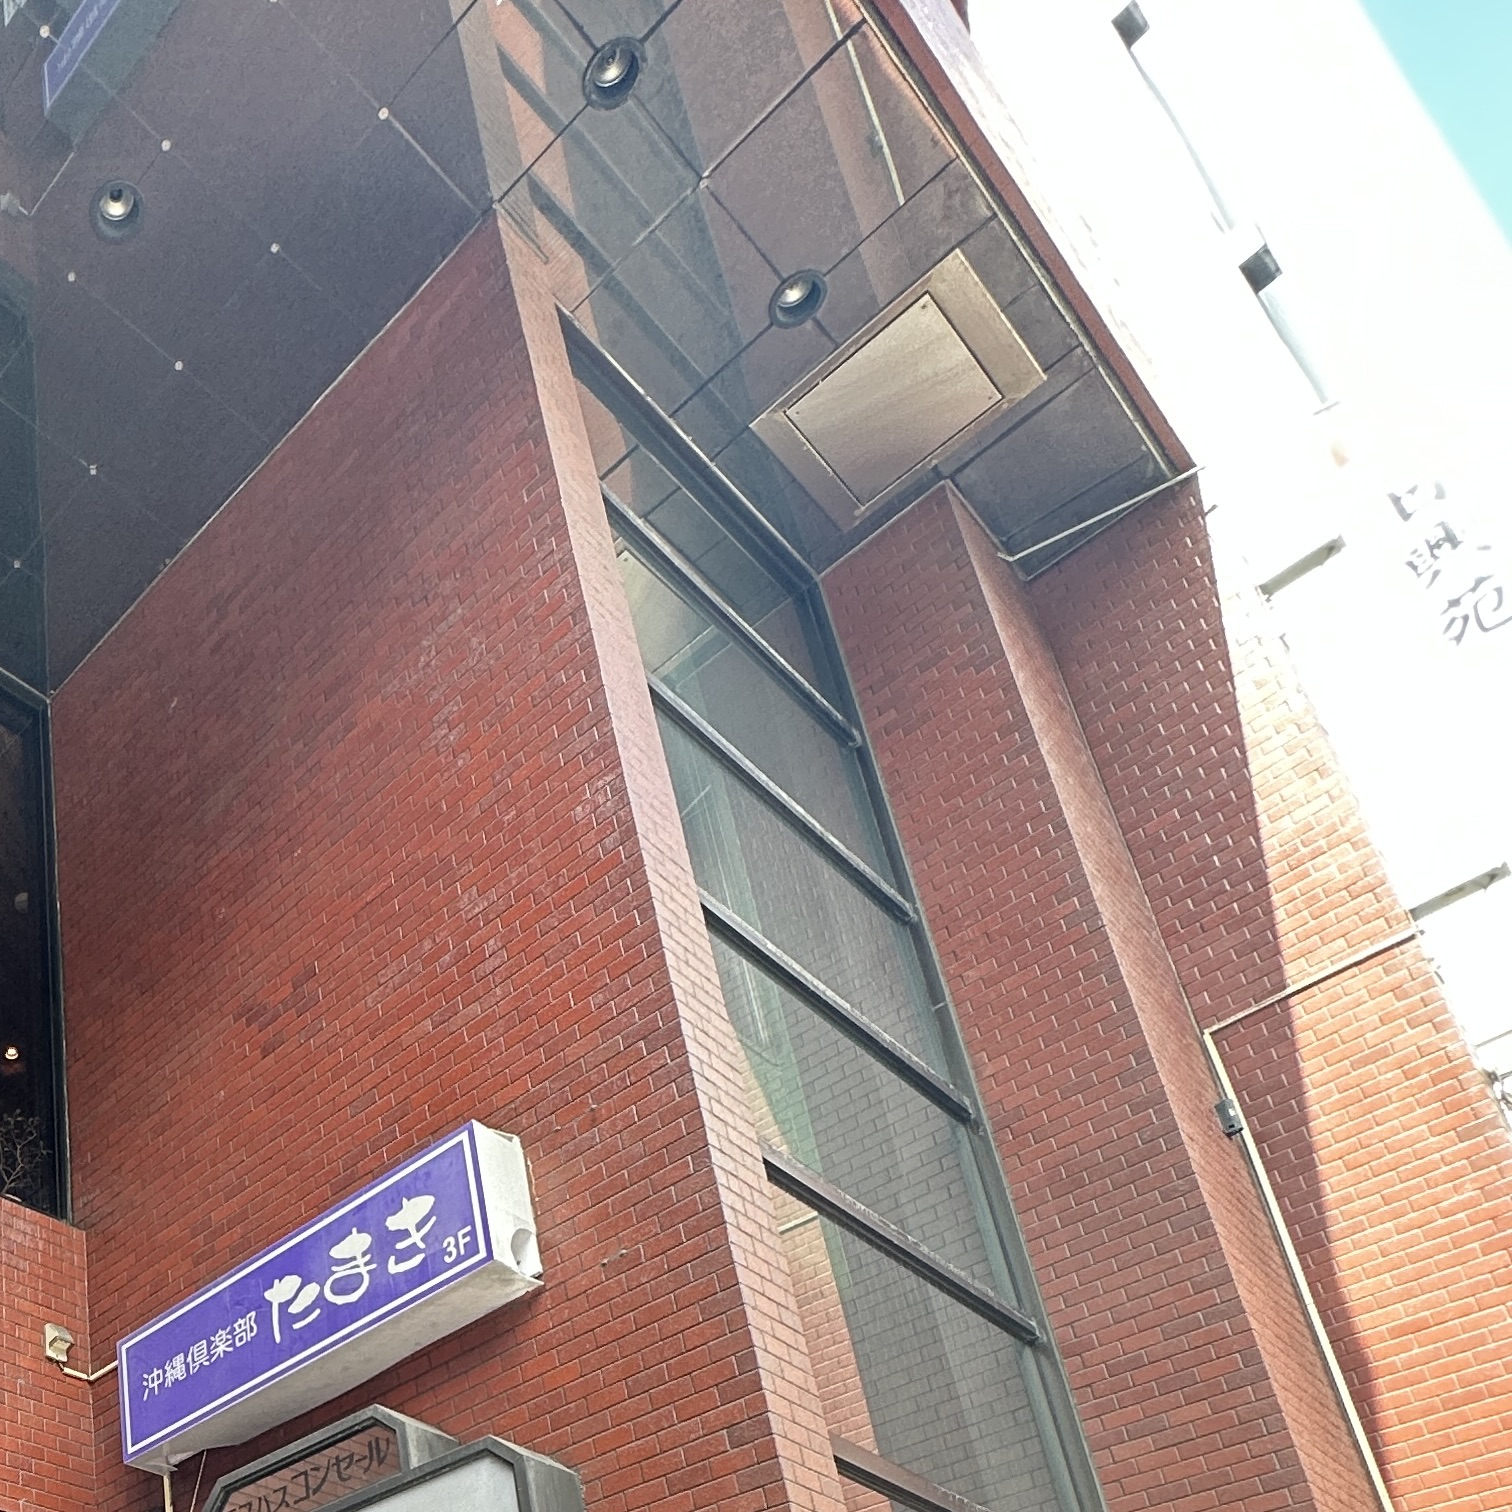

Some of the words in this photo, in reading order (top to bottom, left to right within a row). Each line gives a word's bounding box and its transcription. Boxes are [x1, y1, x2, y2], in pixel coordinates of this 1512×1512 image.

[142, 1316, 258, 1401] 沖縄倶楽部
[265, 1194, 436, 1345] たまき
[442, 1225, 473, 1265] 3F
